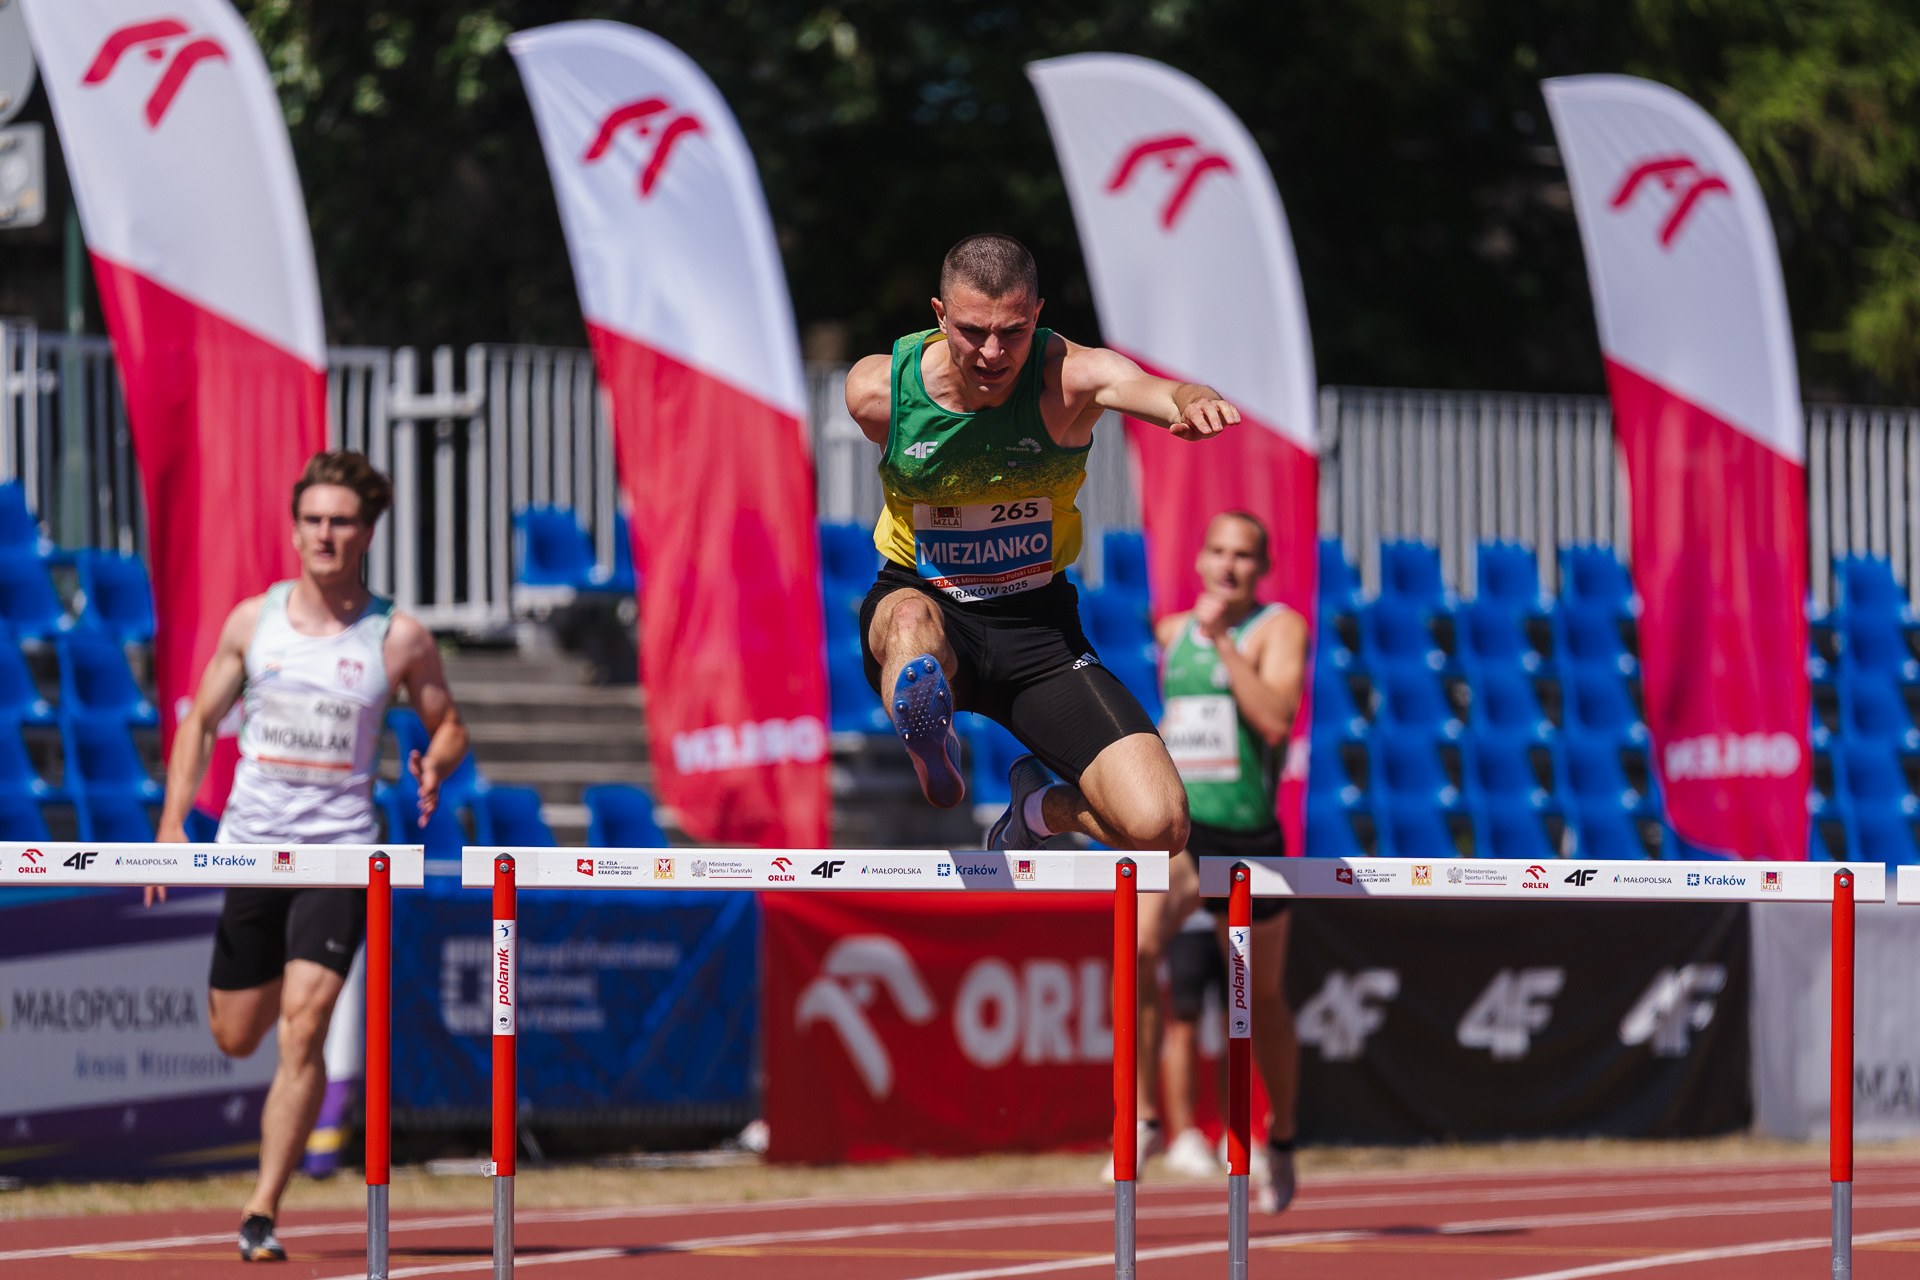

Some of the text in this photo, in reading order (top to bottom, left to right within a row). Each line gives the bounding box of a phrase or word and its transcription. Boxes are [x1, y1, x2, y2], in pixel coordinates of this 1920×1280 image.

[904, 441, 938, 459] 4F
[933, 518, 960, 526] MZLA
[990, 502, 1039, 524] 265
[920, 533, 1048, 566] MIEZIANKO
[961, 576, 1006, 585] Mistrzostwa
[1006, 569, 1027, 580] Polski
[1027, 566, 1041, 574] U23
[947, 580, 1028, 600] KRAKÓW 2025
[63, 852, 98, 870] 4F
[126, 858, 178, 866] MAŁOPOLSKA
[212, 855, 256, 866] Kraków
[811, 861, 846, 878] 4F
[955, 864, 998, 875] Kraków
[1564, 869, 1598, 887] 4F
[1623, 876, 1673, 884] MAŁOPOLSKA
[1704, 875, 1746, 886] Kraków
[497, 947, 512, 1006] polanik
[1232, 953, 1248, 1010] polanik
[955, 958, 1114, 1068] ORL
[1296, 968, 1400, 1061] 4F
[1457, 967, 1567, 1060] 4F
[1619, 963, 1728, 1058] 4F
